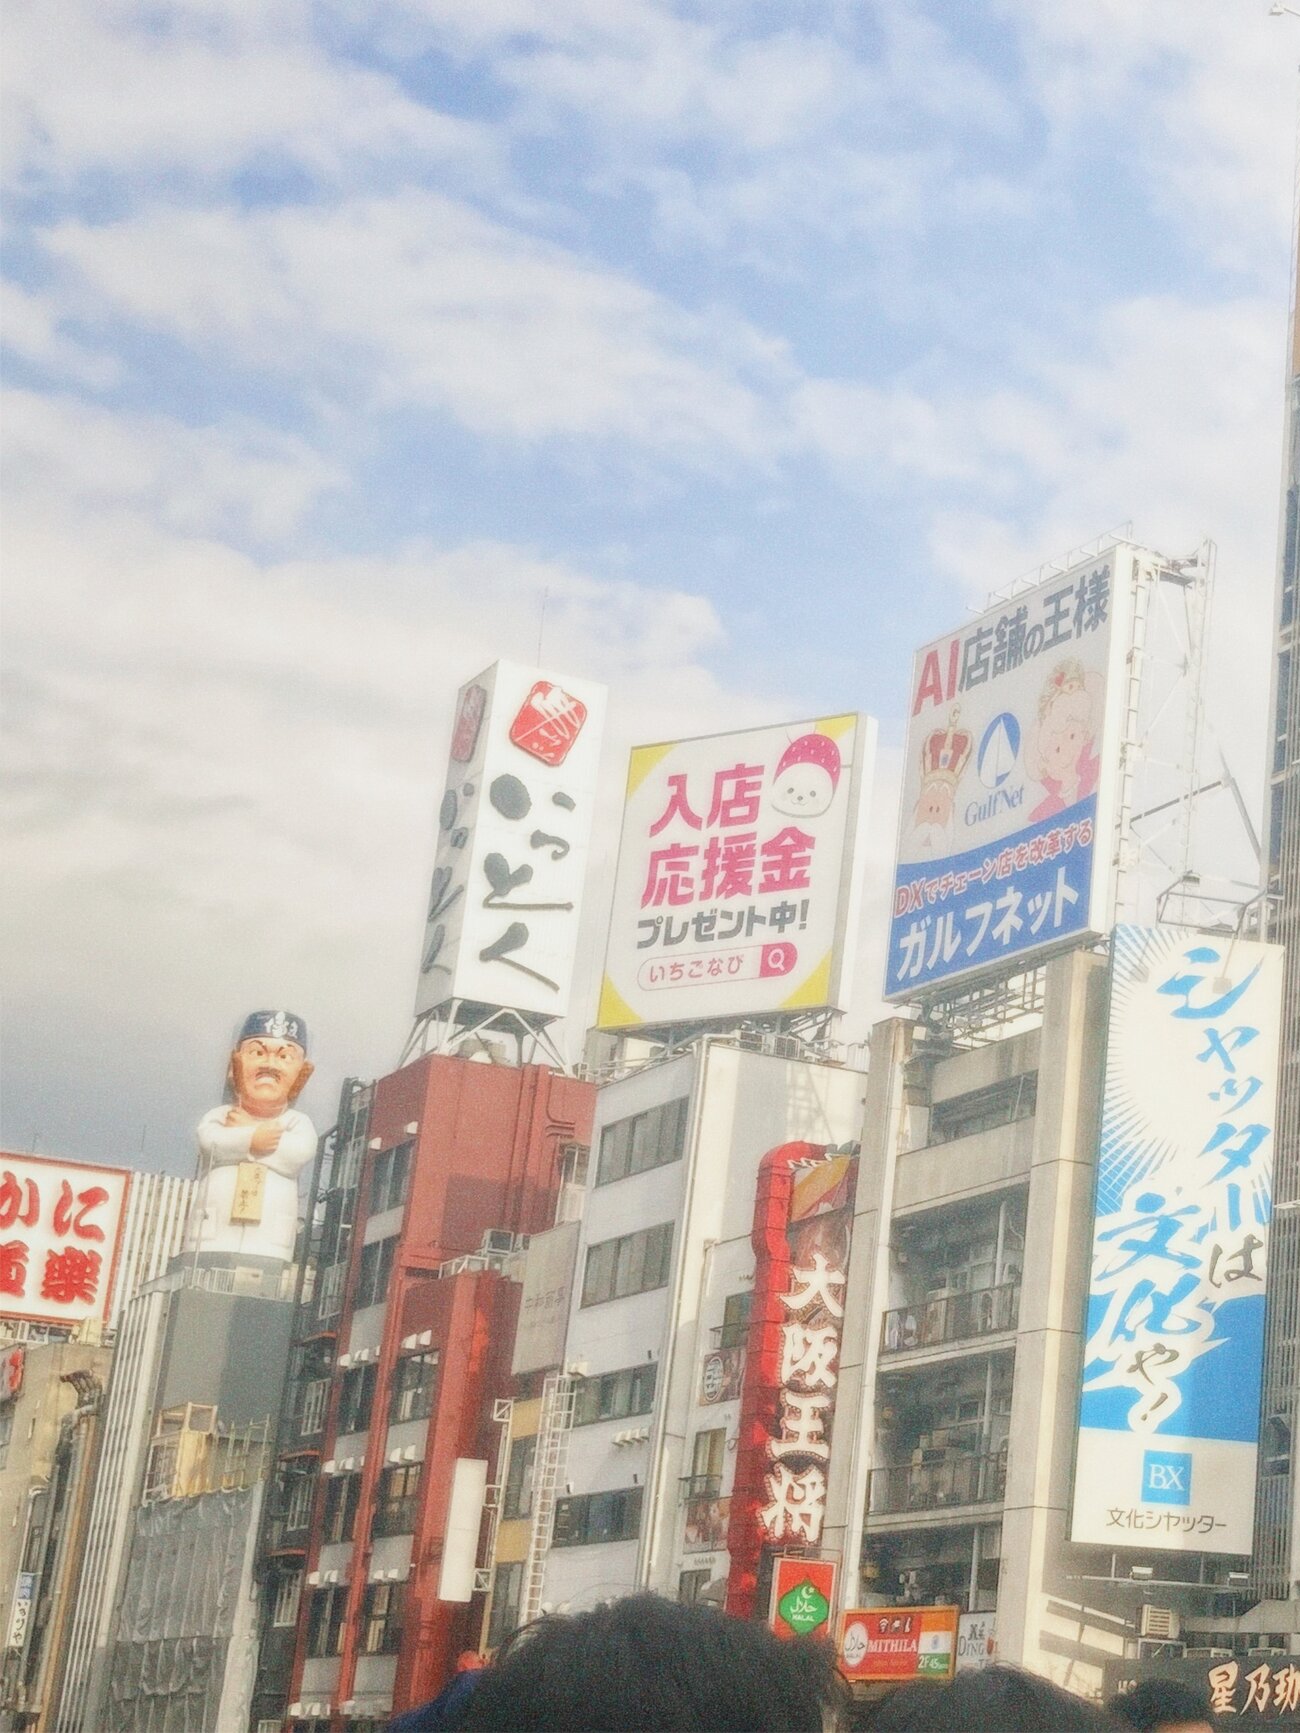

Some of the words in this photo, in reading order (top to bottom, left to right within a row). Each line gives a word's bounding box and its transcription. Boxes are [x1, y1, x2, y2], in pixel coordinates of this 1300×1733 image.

[649, 763, 765, 838] 入店
[640, 826, 816, 909] 応援金
[893, 816, 1094, 918] DXでチェーン店を改革する
[636, 898, 811, 949] プレゼント中!
[896, 866, 1079, 981] ガルフネット
[0, 1170, 110, 1244] かに
[762, 1252, 844, 1545] 大阪王将
[1148, 1460, 1185, 1493] BX
[868, 1639, 918, 1653] MITHILA
[957, 1635, 985, 1657] DING
